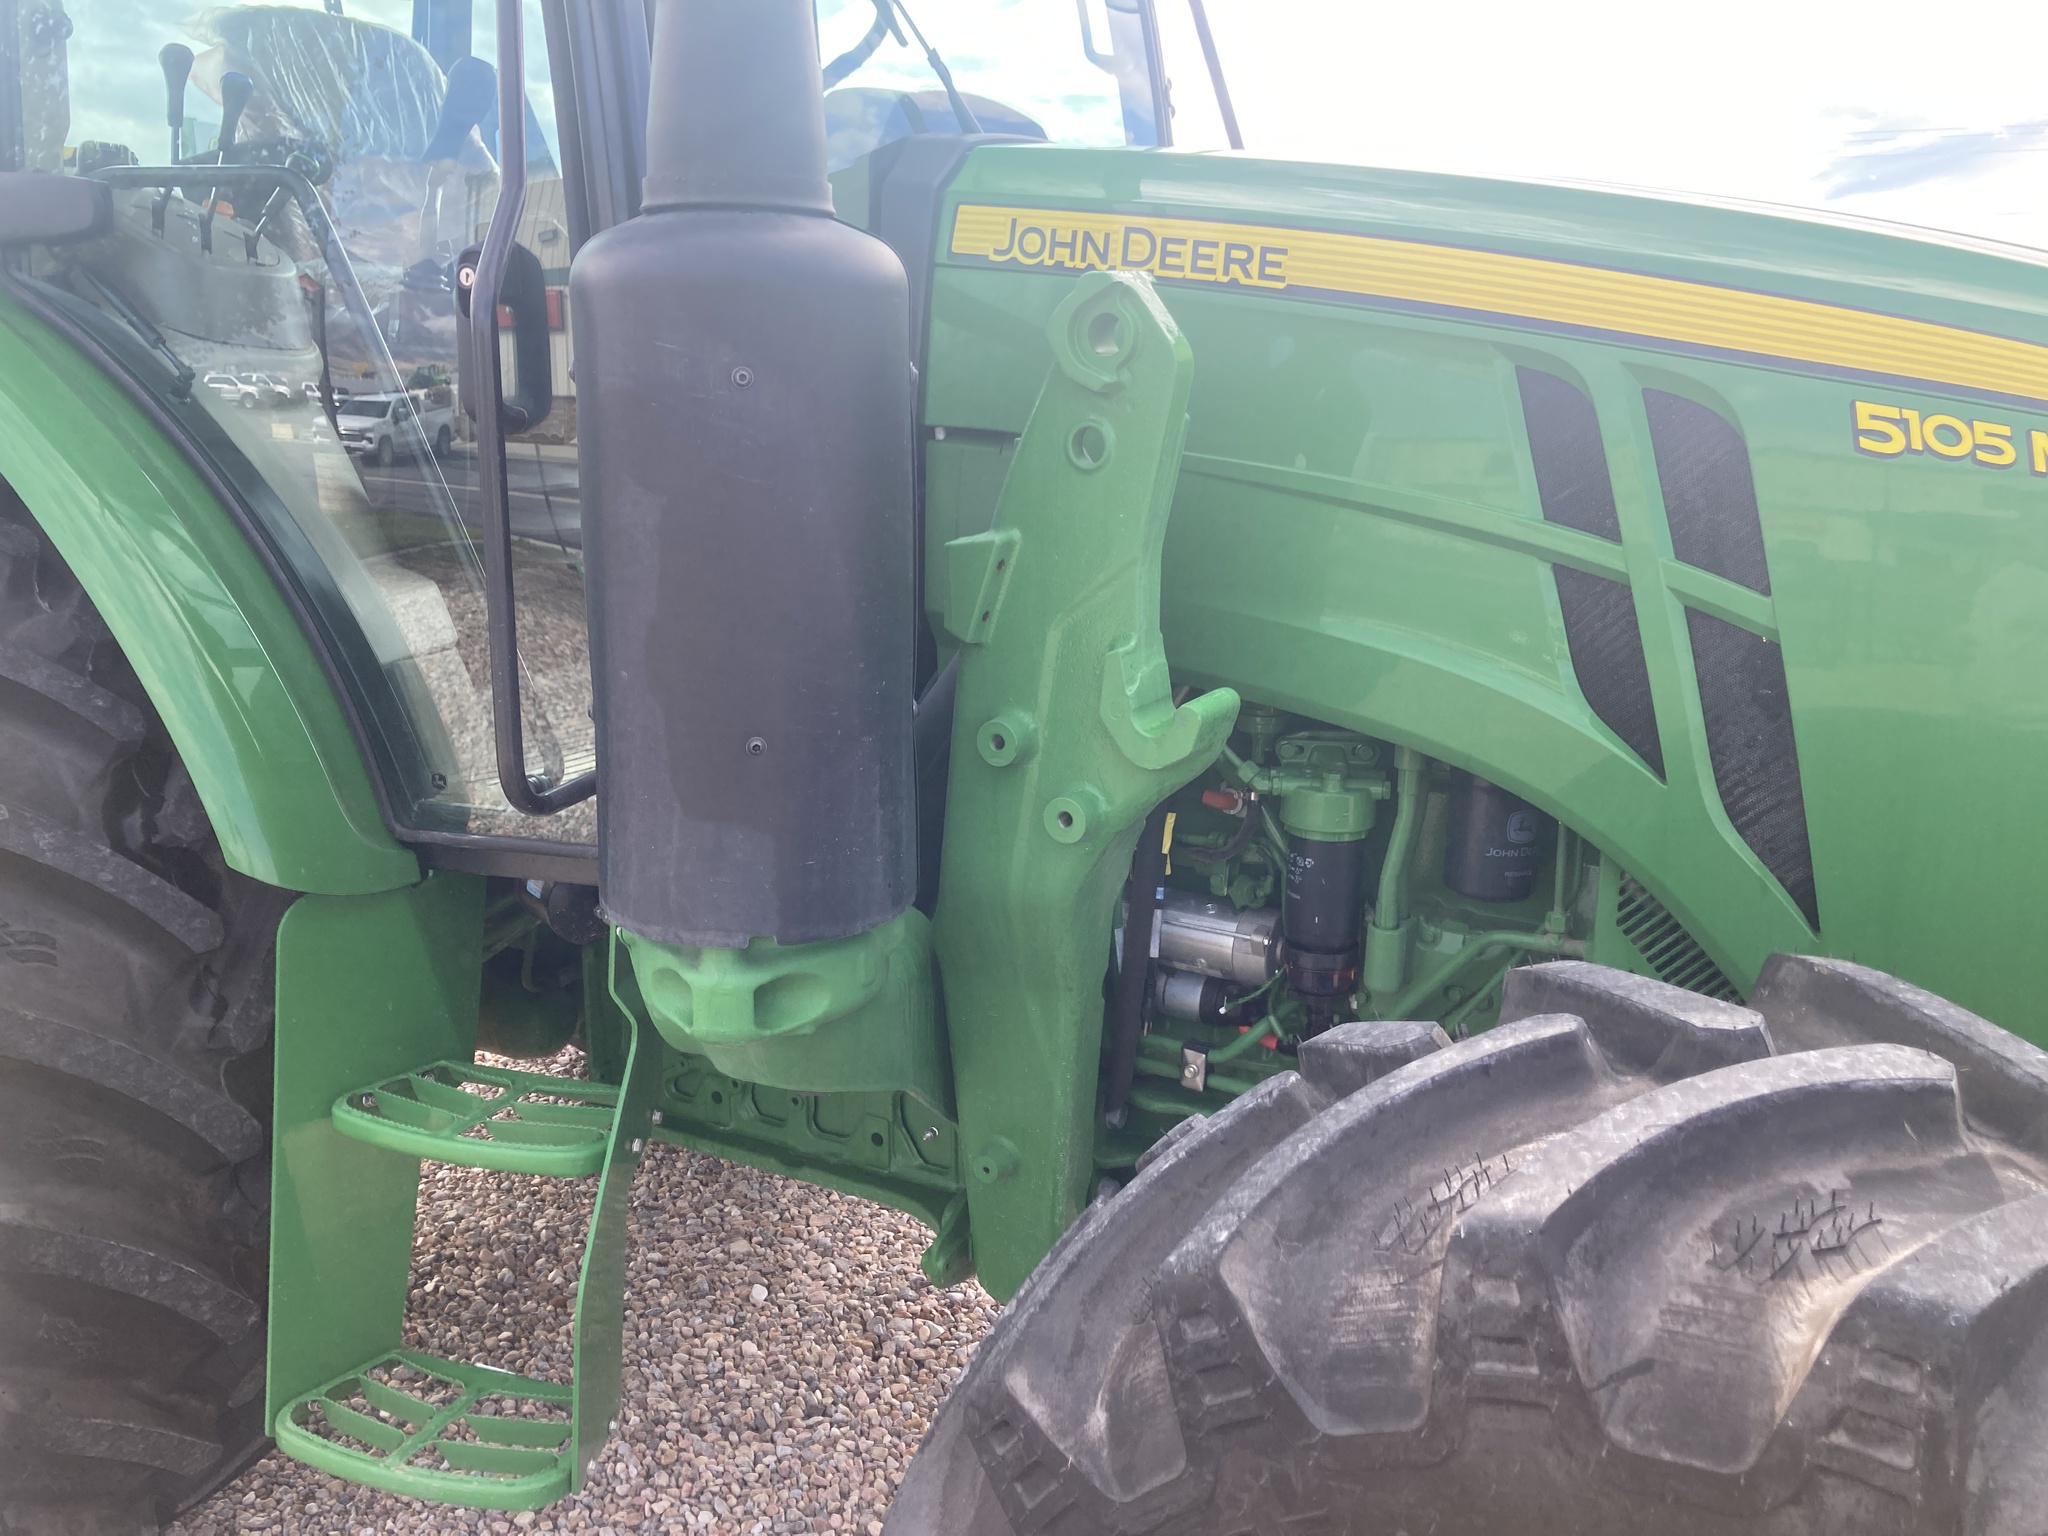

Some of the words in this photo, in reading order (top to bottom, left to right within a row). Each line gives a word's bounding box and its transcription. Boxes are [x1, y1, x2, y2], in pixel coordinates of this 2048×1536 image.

[992, 217, 1111, 265] JOHN
[1120, 226, 1289, 284] DEERE
[1850, 399, 2017, 470] 5105
[1485, 847, 1519, 857] JOHN
